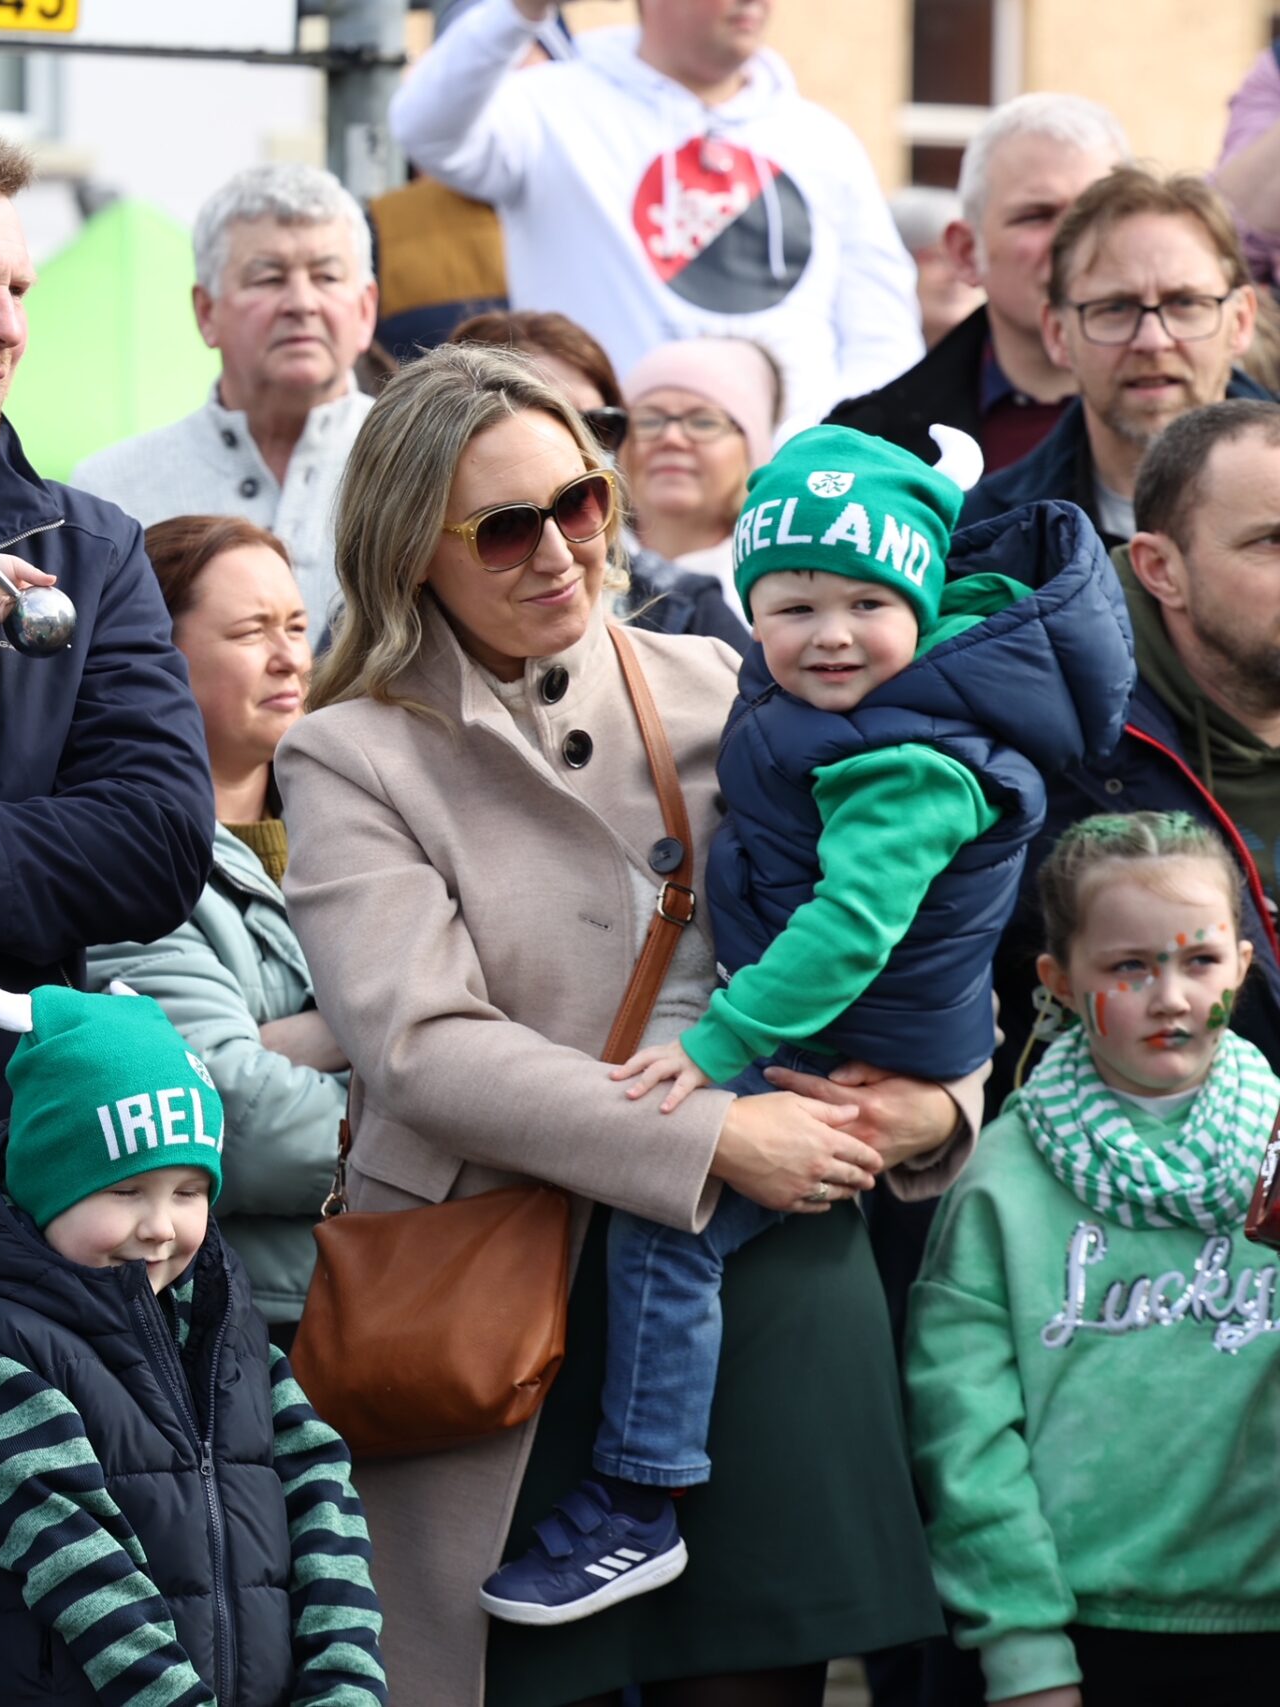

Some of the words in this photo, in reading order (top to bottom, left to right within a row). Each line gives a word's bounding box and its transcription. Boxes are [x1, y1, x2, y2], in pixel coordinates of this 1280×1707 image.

[732, 497, 931, 587] IRELAND
[96, 1087, 224, 1161] IREL
[1040, 1221, 1280, 1355] Lucky
